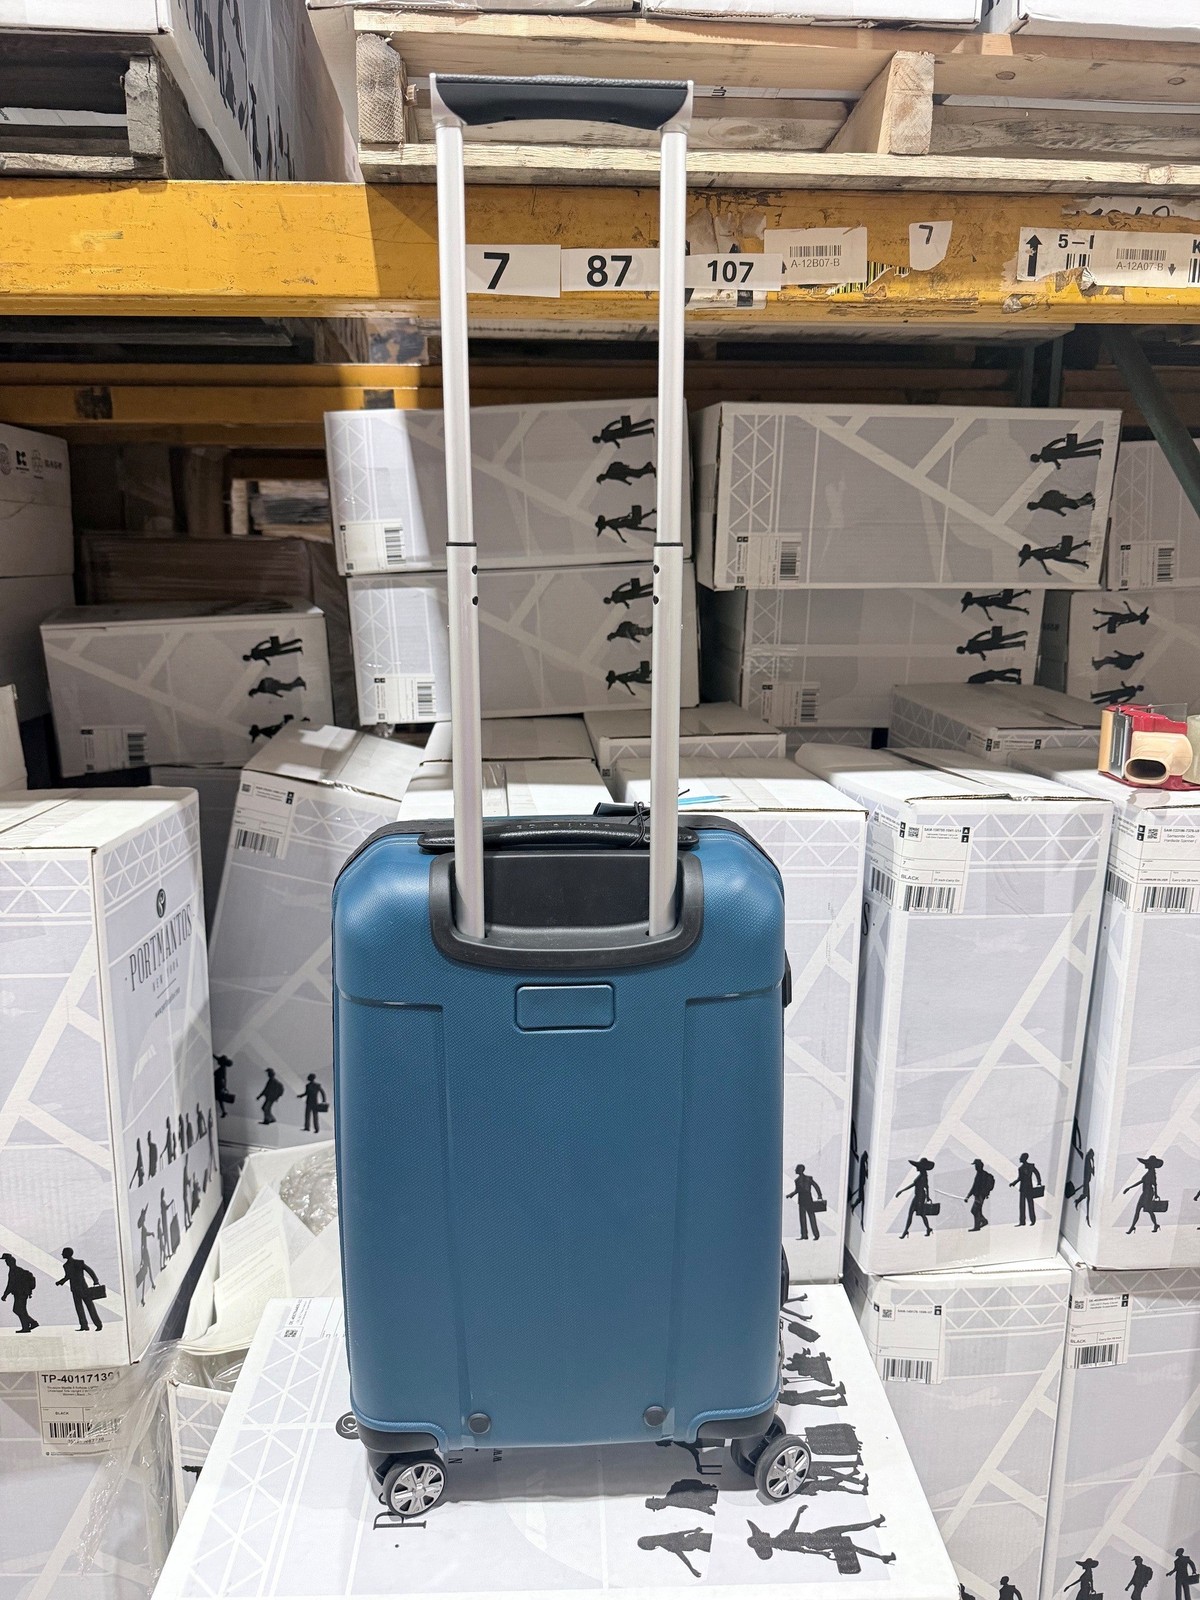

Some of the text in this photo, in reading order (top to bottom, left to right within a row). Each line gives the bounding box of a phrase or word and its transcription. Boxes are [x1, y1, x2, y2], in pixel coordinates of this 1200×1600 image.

[918, 224, 933, 245] 7
[483, 251, 510, 290] 7
[586, 254, 633, 287] 87
[707, 260, 754, 283] 107
[790, 257, 841, 268] A-12B07-B
[1116, 262, 1164, 272] A-12A07-B
[129, 903, 192, 992] PORTMANTOS
